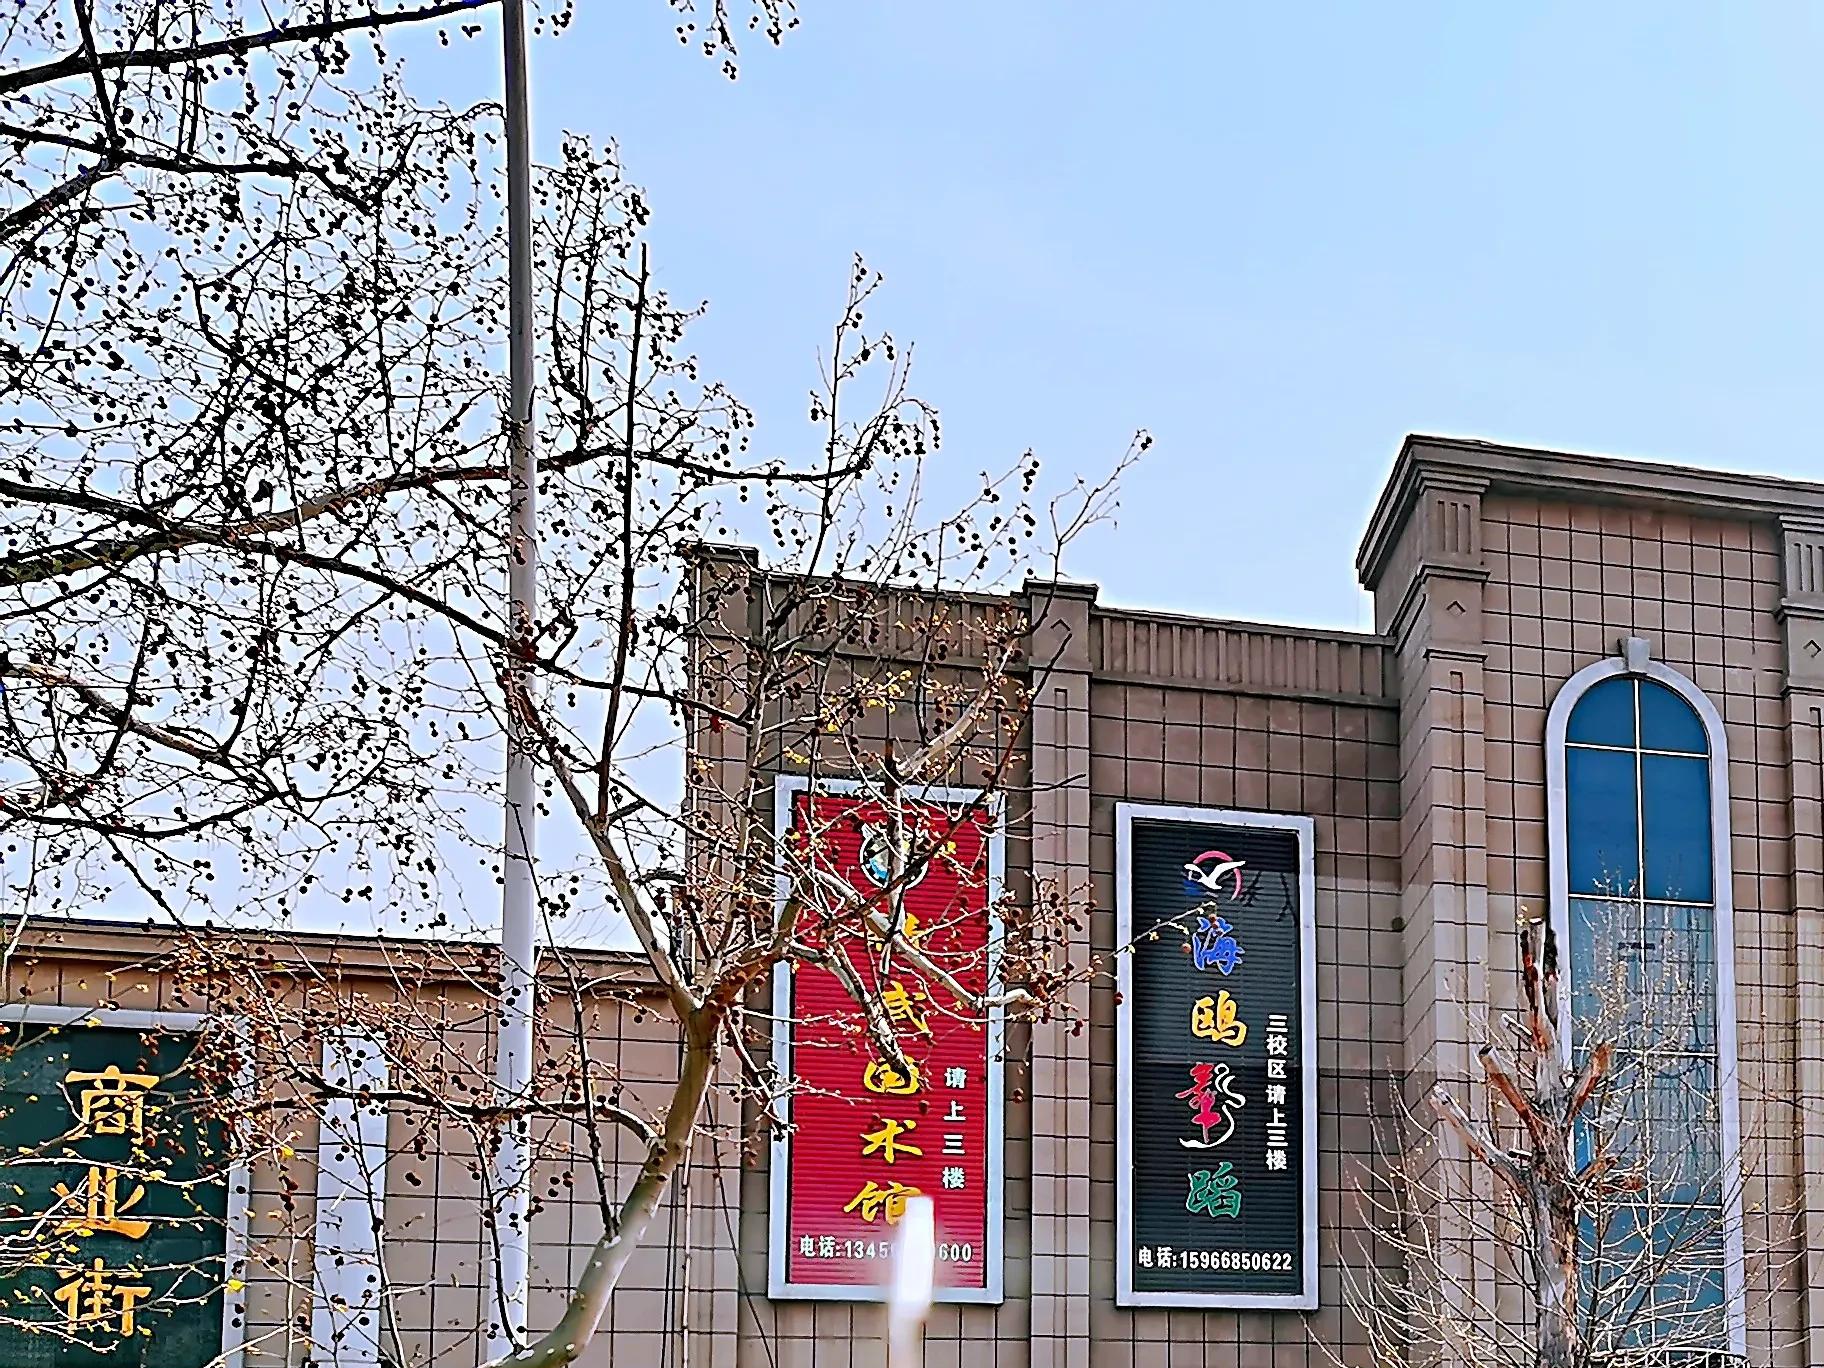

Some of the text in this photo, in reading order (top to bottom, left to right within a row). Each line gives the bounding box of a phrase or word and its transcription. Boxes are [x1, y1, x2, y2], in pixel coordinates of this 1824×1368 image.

[842, 910, 930, 1226] 武国术馆
[940, 1065, 969, 1191] 请上三楼
[1264, 1013, 1289, 1172] 三校区请上三楼
[54, 1064, 162, 1339] 商业街
[1137, 1245, 1294, 1273] 电话:15966850622
